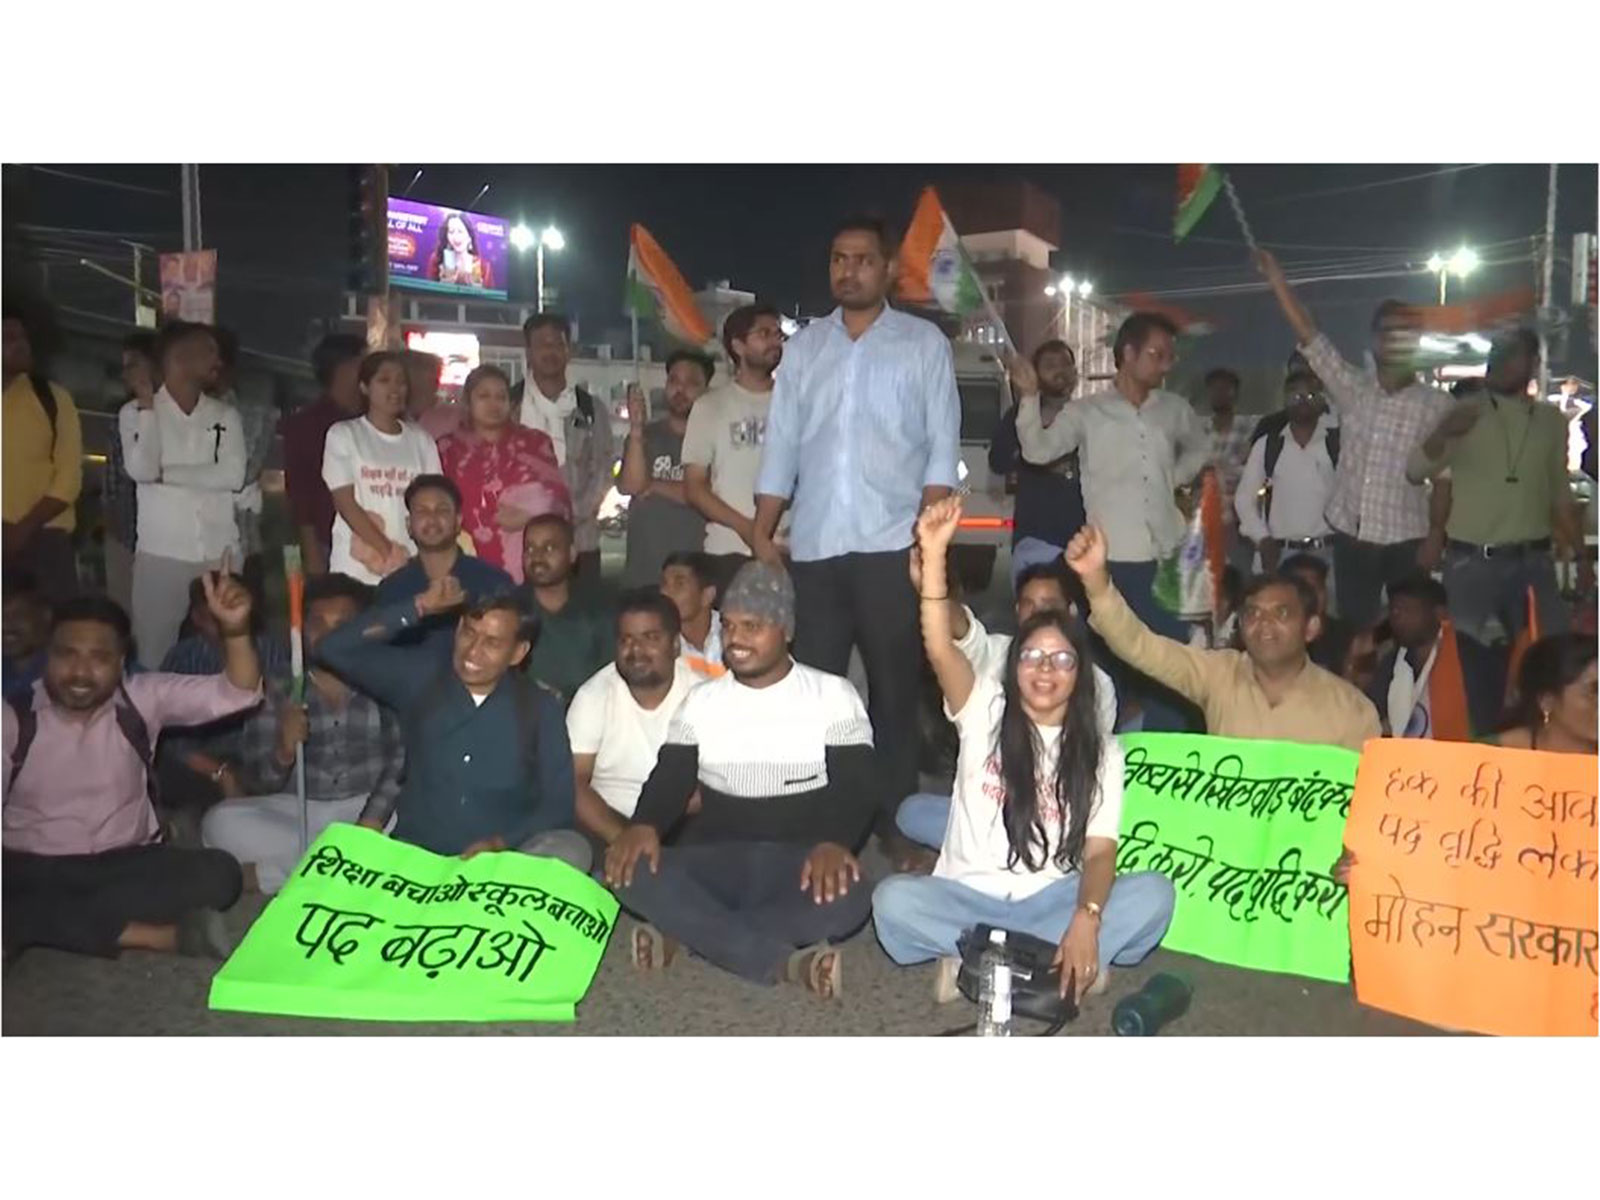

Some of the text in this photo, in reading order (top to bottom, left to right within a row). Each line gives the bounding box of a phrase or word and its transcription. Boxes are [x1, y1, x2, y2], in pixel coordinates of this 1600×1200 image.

[406, 223, 423, 233] ALL
[1460, 761, 1503, 810] की
[1520, 783, 1598, 828] आव
[300, 845, 385, 888] शिक्षा
[1379, 813, 1430, 855] पद
[1517, 831, 1598, 881] लेक
[295, 903, 557, 983] पद बढ़ाओ
[1364, 873, 1469, 956] मोहन
